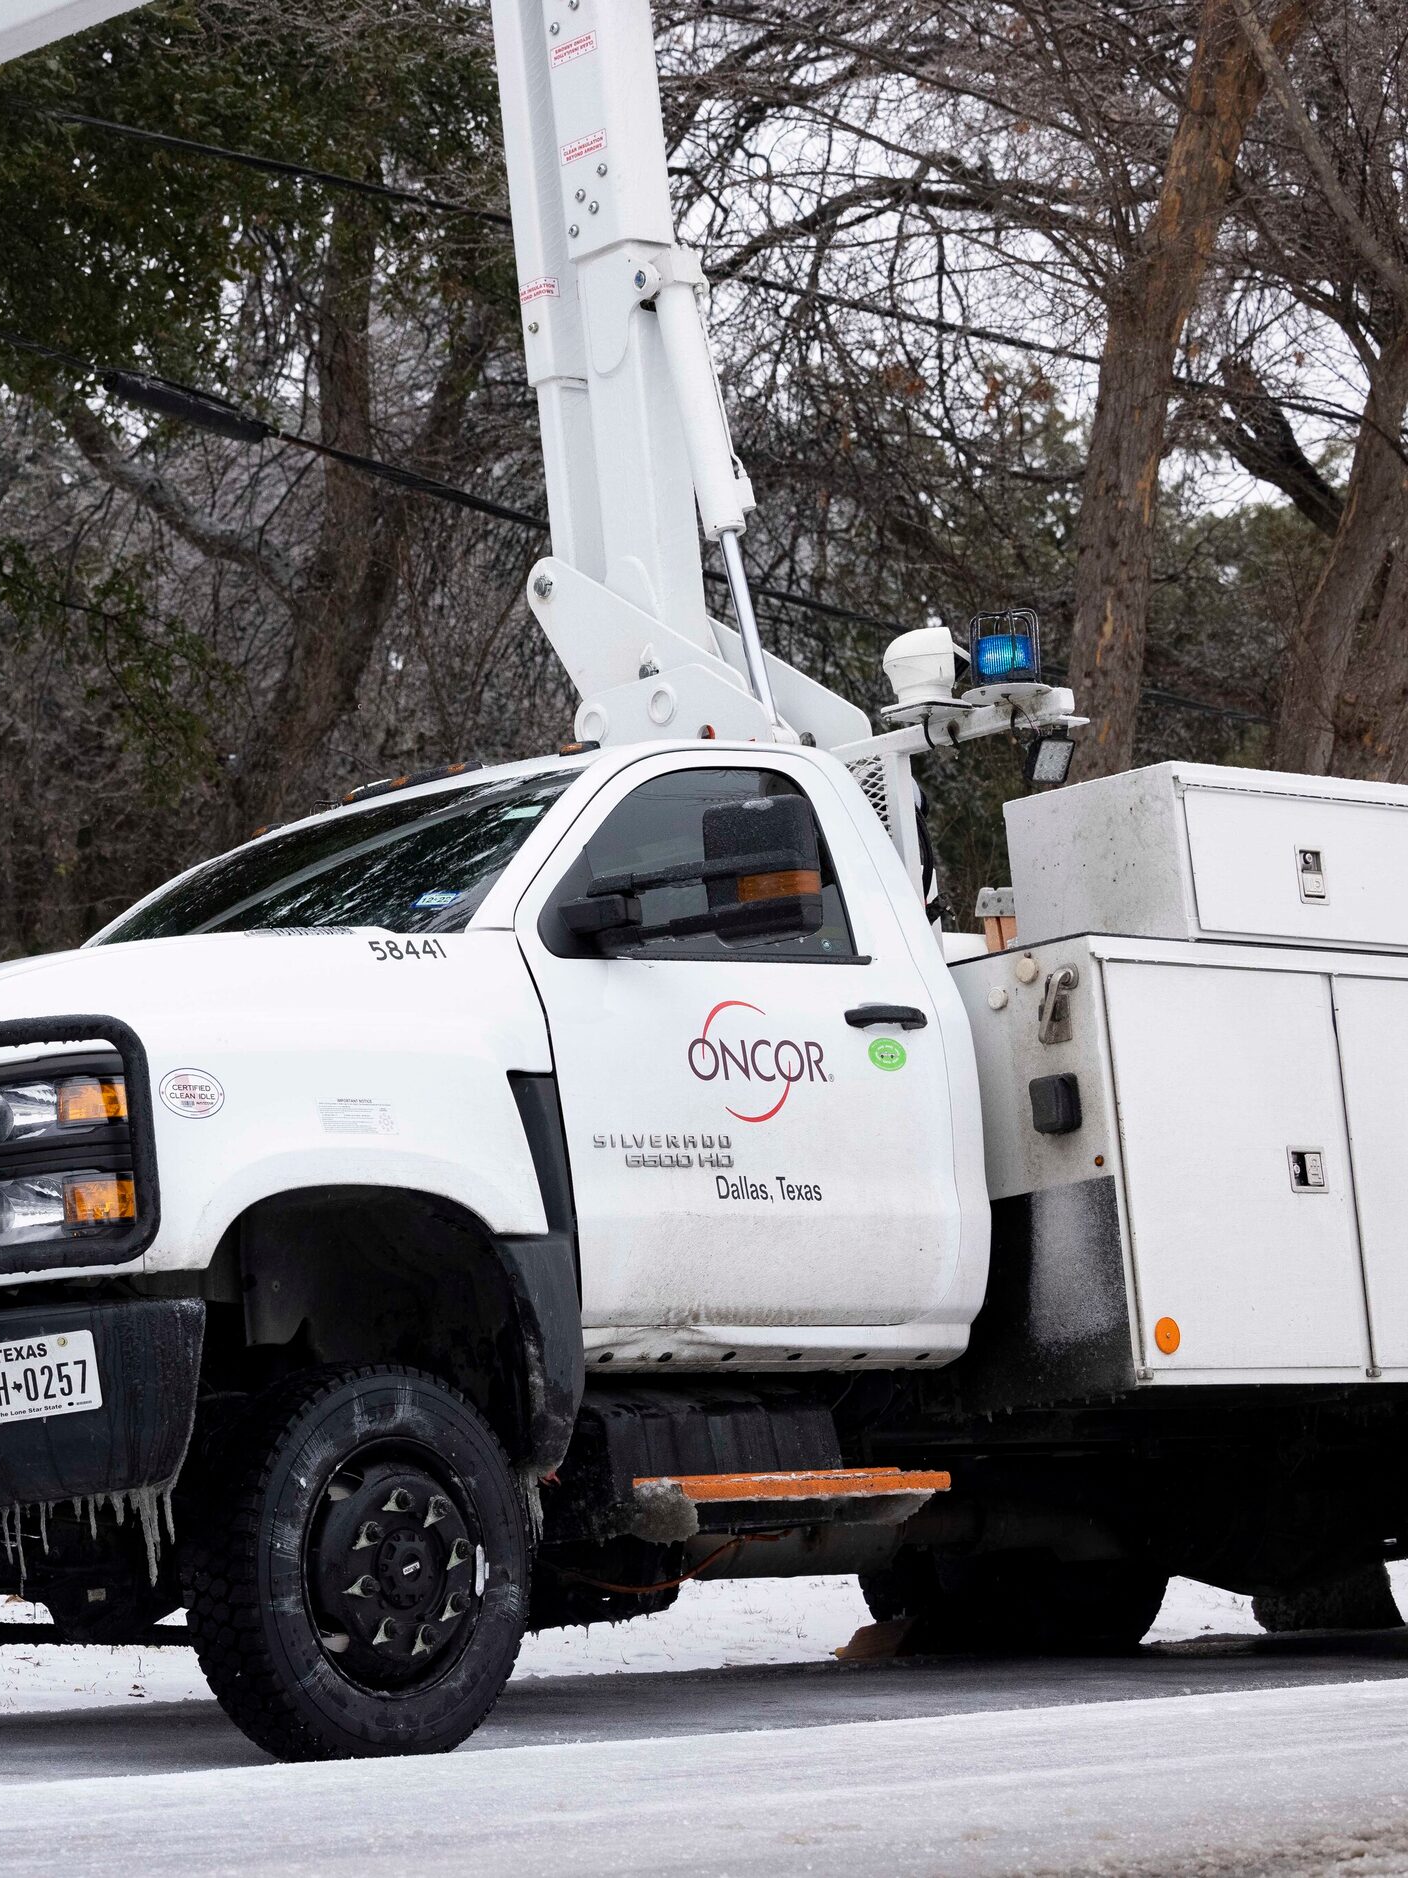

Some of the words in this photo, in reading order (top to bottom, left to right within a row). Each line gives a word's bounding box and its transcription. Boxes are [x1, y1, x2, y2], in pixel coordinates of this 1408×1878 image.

[563, 147, 577, 156] CLEAR
[578, 136, 603, 150] INSULATION
[367, 939, 447, 961] 58441
[171, 1084, 211, 1092] CERTIFIED
[593, 1133, 733, 1149] SILVERADO
[625, 1152, 693, 1169] 6500
[698, 1152, 734, 1169] HD
[715, 1175, 774, 1203] Dallas,
[775, 1176, 823, 1201] Texas
[22, 1359, 87, 1402] 0257
[10, 1408, 27, 1416] Lone
